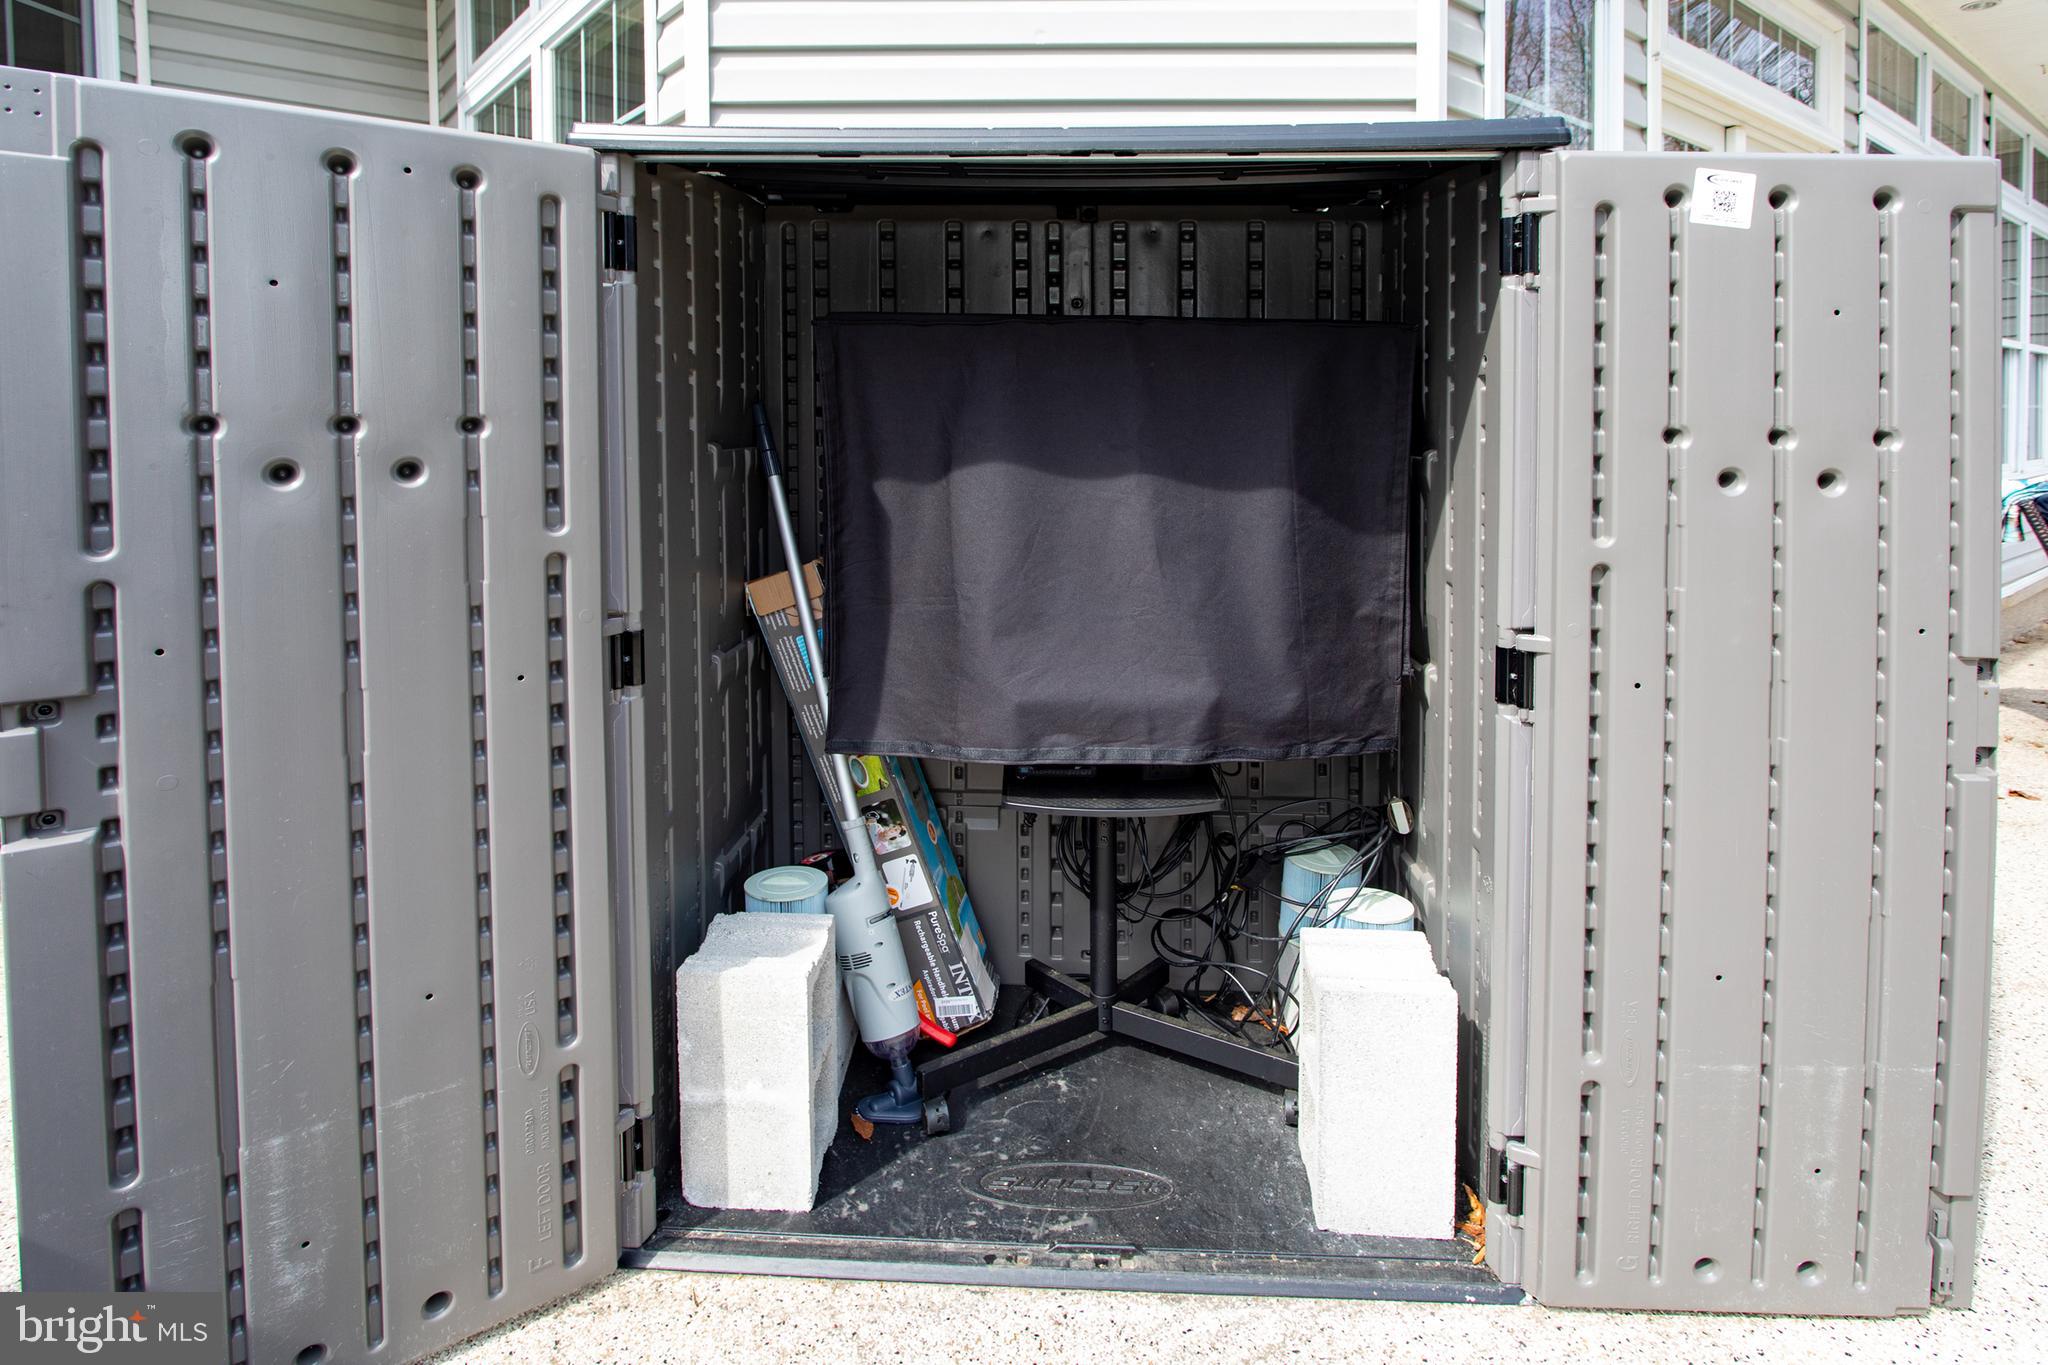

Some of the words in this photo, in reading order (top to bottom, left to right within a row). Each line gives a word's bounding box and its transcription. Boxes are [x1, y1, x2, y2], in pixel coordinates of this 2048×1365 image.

[913, 919, 937, 967] Rechargeable
[932, 966, 952, 998] Handhel
[948, 960, 985, 1024] INTX
[536, 1161, 553, 1207] DOOR
[1627, 1157, 1643, 1199] DOOR
[538, 1209, 553, 1242] LEFT
[1626, 1201, 1641, 1246] RIGHT
[528, 1257, 554, 1275] F
[1616, 1256, 1639, 1272] G
